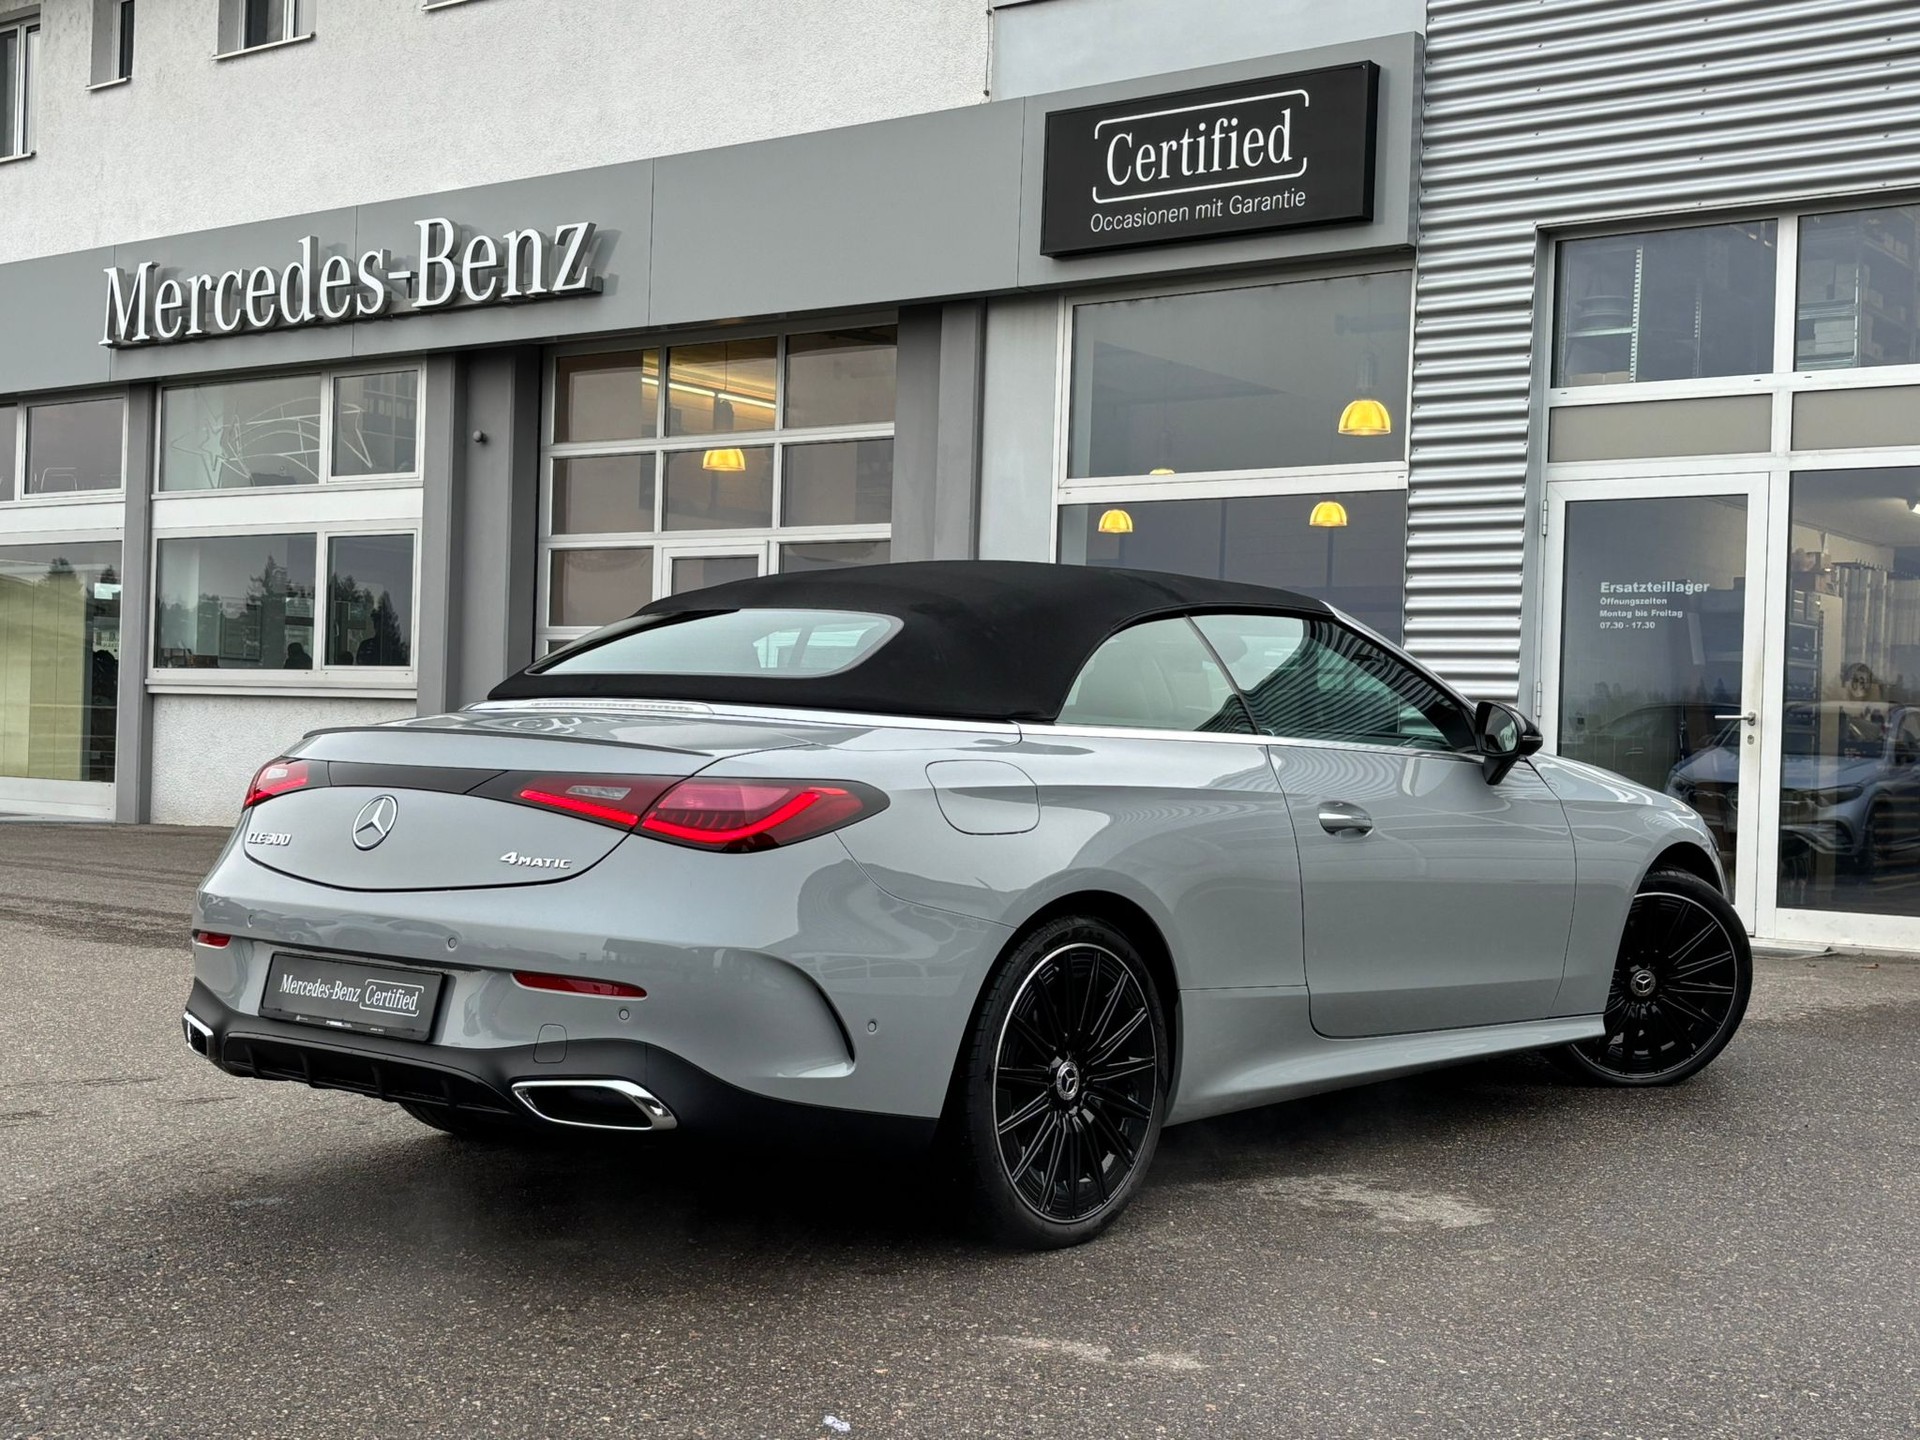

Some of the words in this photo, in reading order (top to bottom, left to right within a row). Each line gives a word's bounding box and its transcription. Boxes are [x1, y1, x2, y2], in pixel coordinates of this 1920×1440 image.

[1106, 108, 1293, 186] Certified
[1090, 204, 1189, 233] Occasionen
[1195, 199, 1223, 221] mit
[1229, 188, 1306, 215] Garantie
[99, 217, 597, 347] Mercedes-Benz
[1600, 581, 1710, 595] Ersatzteillager
[1600, 597, 1667, 606] Öffnungszeiten
[1600, 610, 1632, 618] Montag
[1651, 609, 1683, 618] Freitag
[1600, 621, 1624, 629] 07.30
[1631, 621, 1656, 629] 17.30
[500, 851, 572, 869] 4MATIC
[279, 974, 362, 1003] Mercedes-Benz
[365, 985, 419, 1011] Certified
